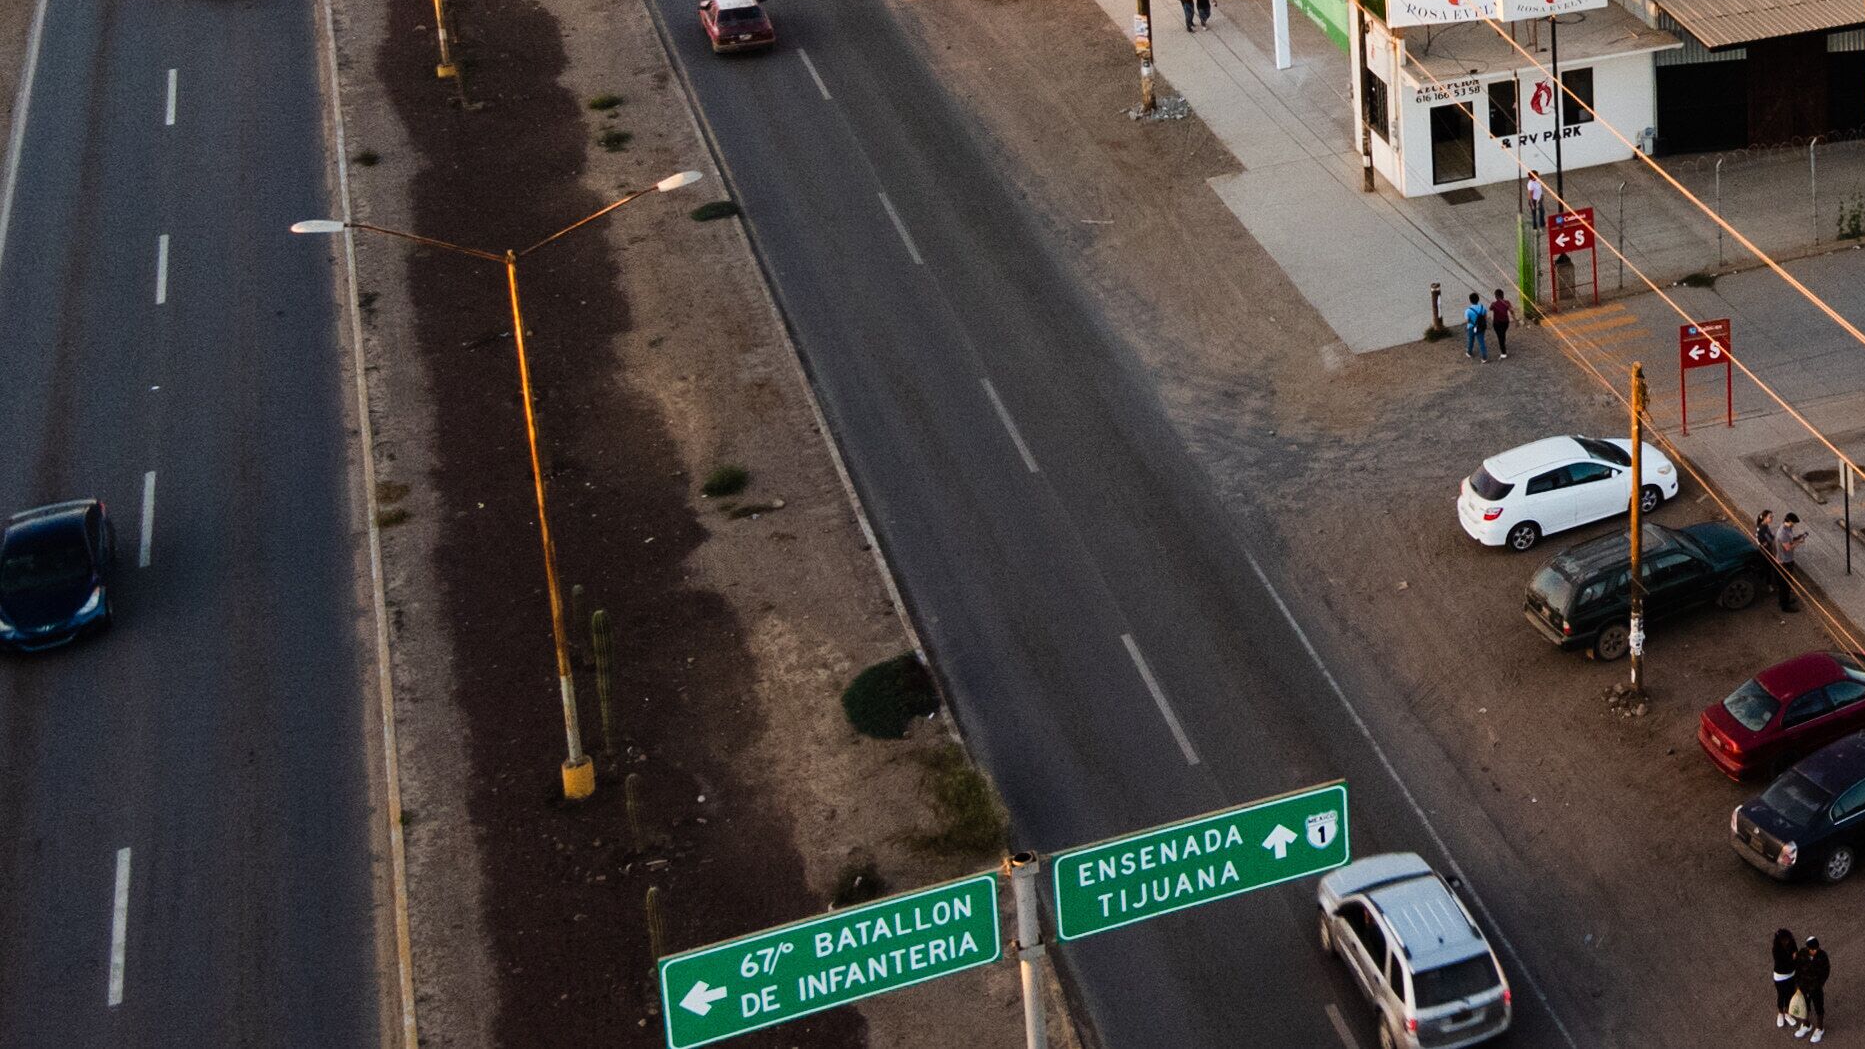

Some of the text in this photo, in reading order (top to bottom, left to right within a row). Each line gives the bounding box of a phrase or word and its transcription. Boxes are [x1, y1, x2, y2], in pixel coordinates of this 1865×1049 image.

[1407, 3, 1447, 20] ROSA
[1078, 824, 1244, 887] ENSENADA
[1317, 825, 1326, 844] 1
[1097, 860, 1240, 918] TIJUANA
[814, 894, 972, 959] BATALLON
[740, 930, 979, 1018] DE INFANTERIA
